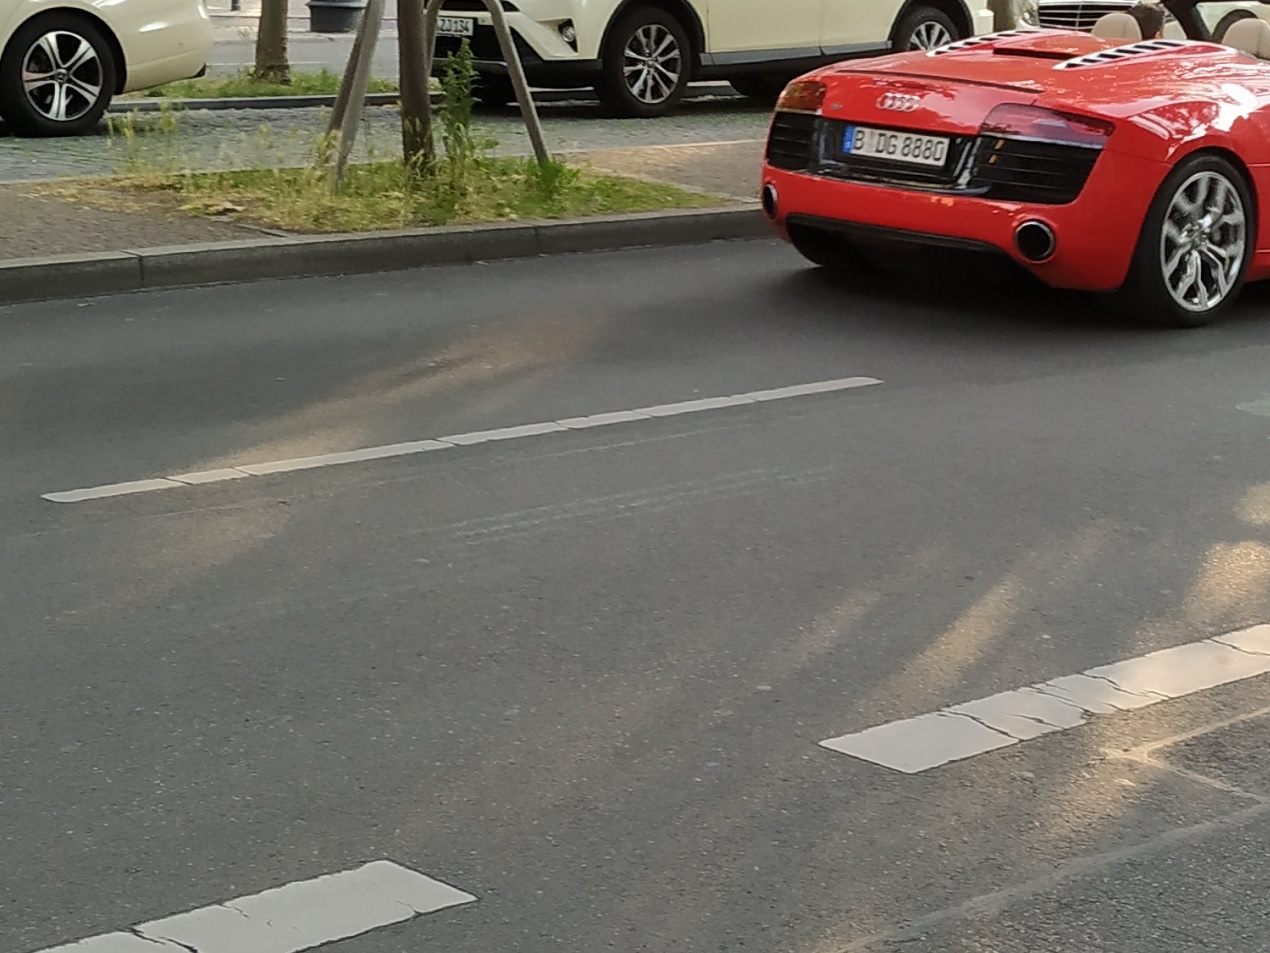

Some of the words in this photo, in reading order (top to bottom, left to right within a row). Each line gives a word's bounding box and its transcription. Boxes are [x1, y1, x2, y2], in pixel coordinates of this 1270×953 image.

[855, 130, 865, 150] B
[875, 133, 897, 154] DG
[902, 137, 944, 161] 8880
